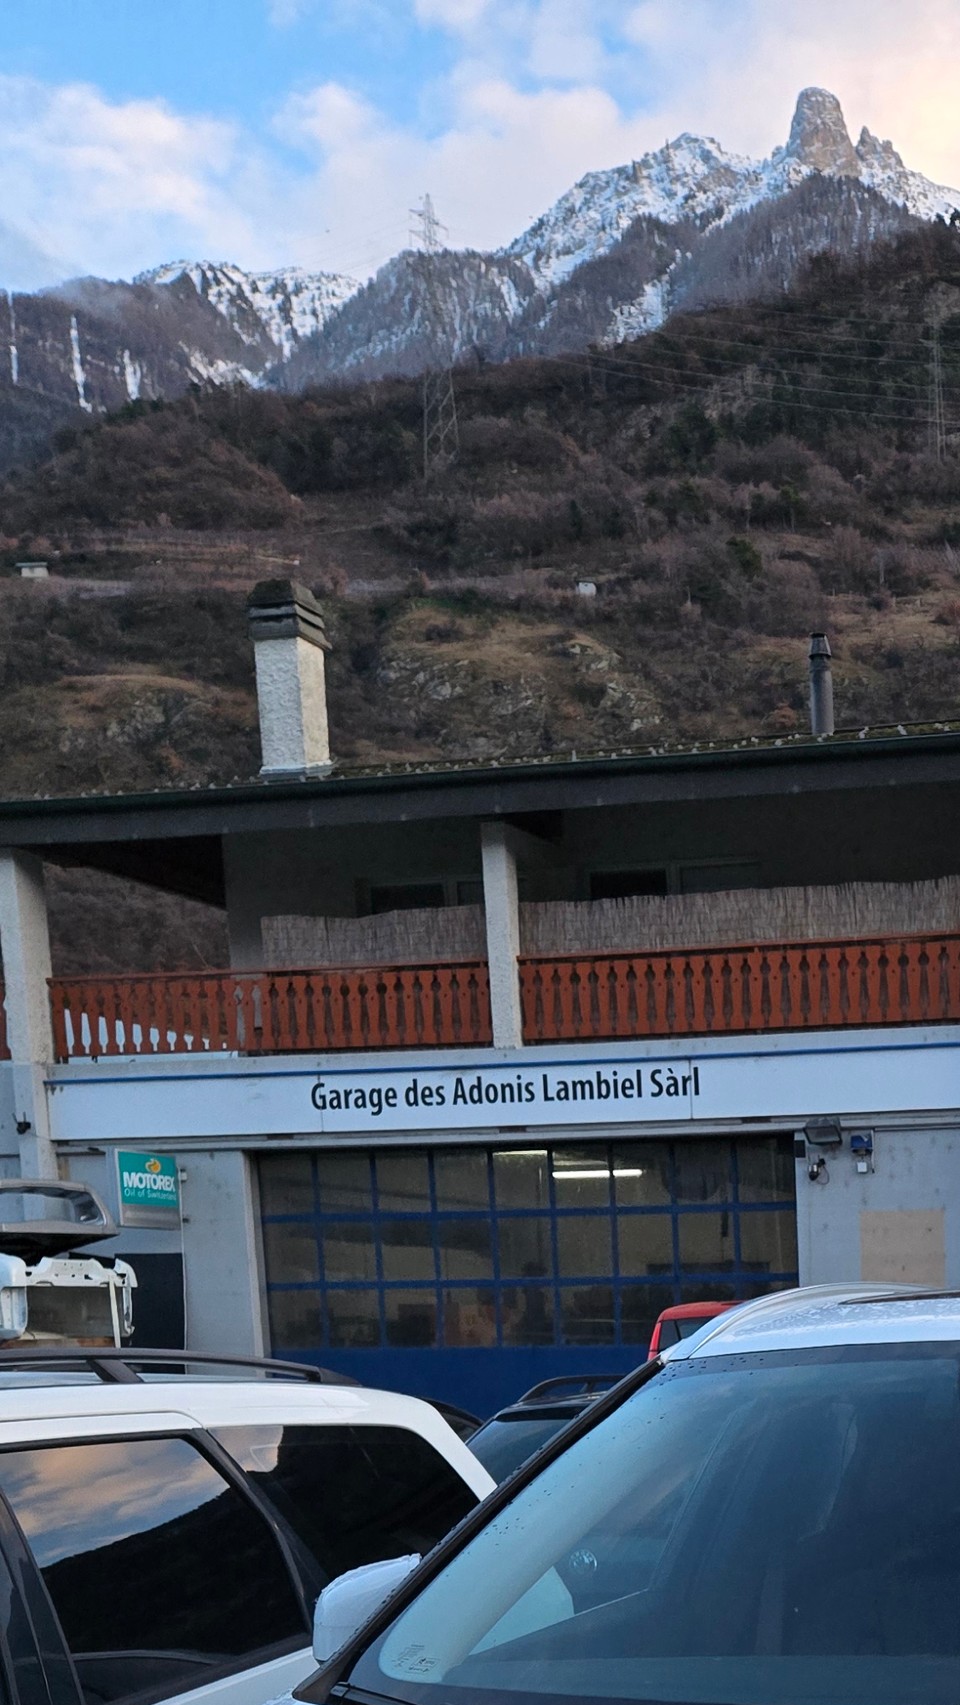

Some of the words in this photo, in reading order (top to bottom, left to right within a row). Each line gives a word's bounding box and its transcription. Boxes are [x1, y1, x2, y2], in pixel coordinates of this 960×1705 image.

[311, 1082, 398, 1116] Garage
[405, 1078, 446, 1107] des
[453, 1074, 535, 1106] Adonis
[542, 1069, 643, 1102] Lambiel
[650, 1066, 700, 1098] Sàrl
[123, 1171, 176, 1192] MOTOREX
[124, 1188, 136, 1197] Oil
[138, 1189, 145, 1198] of
